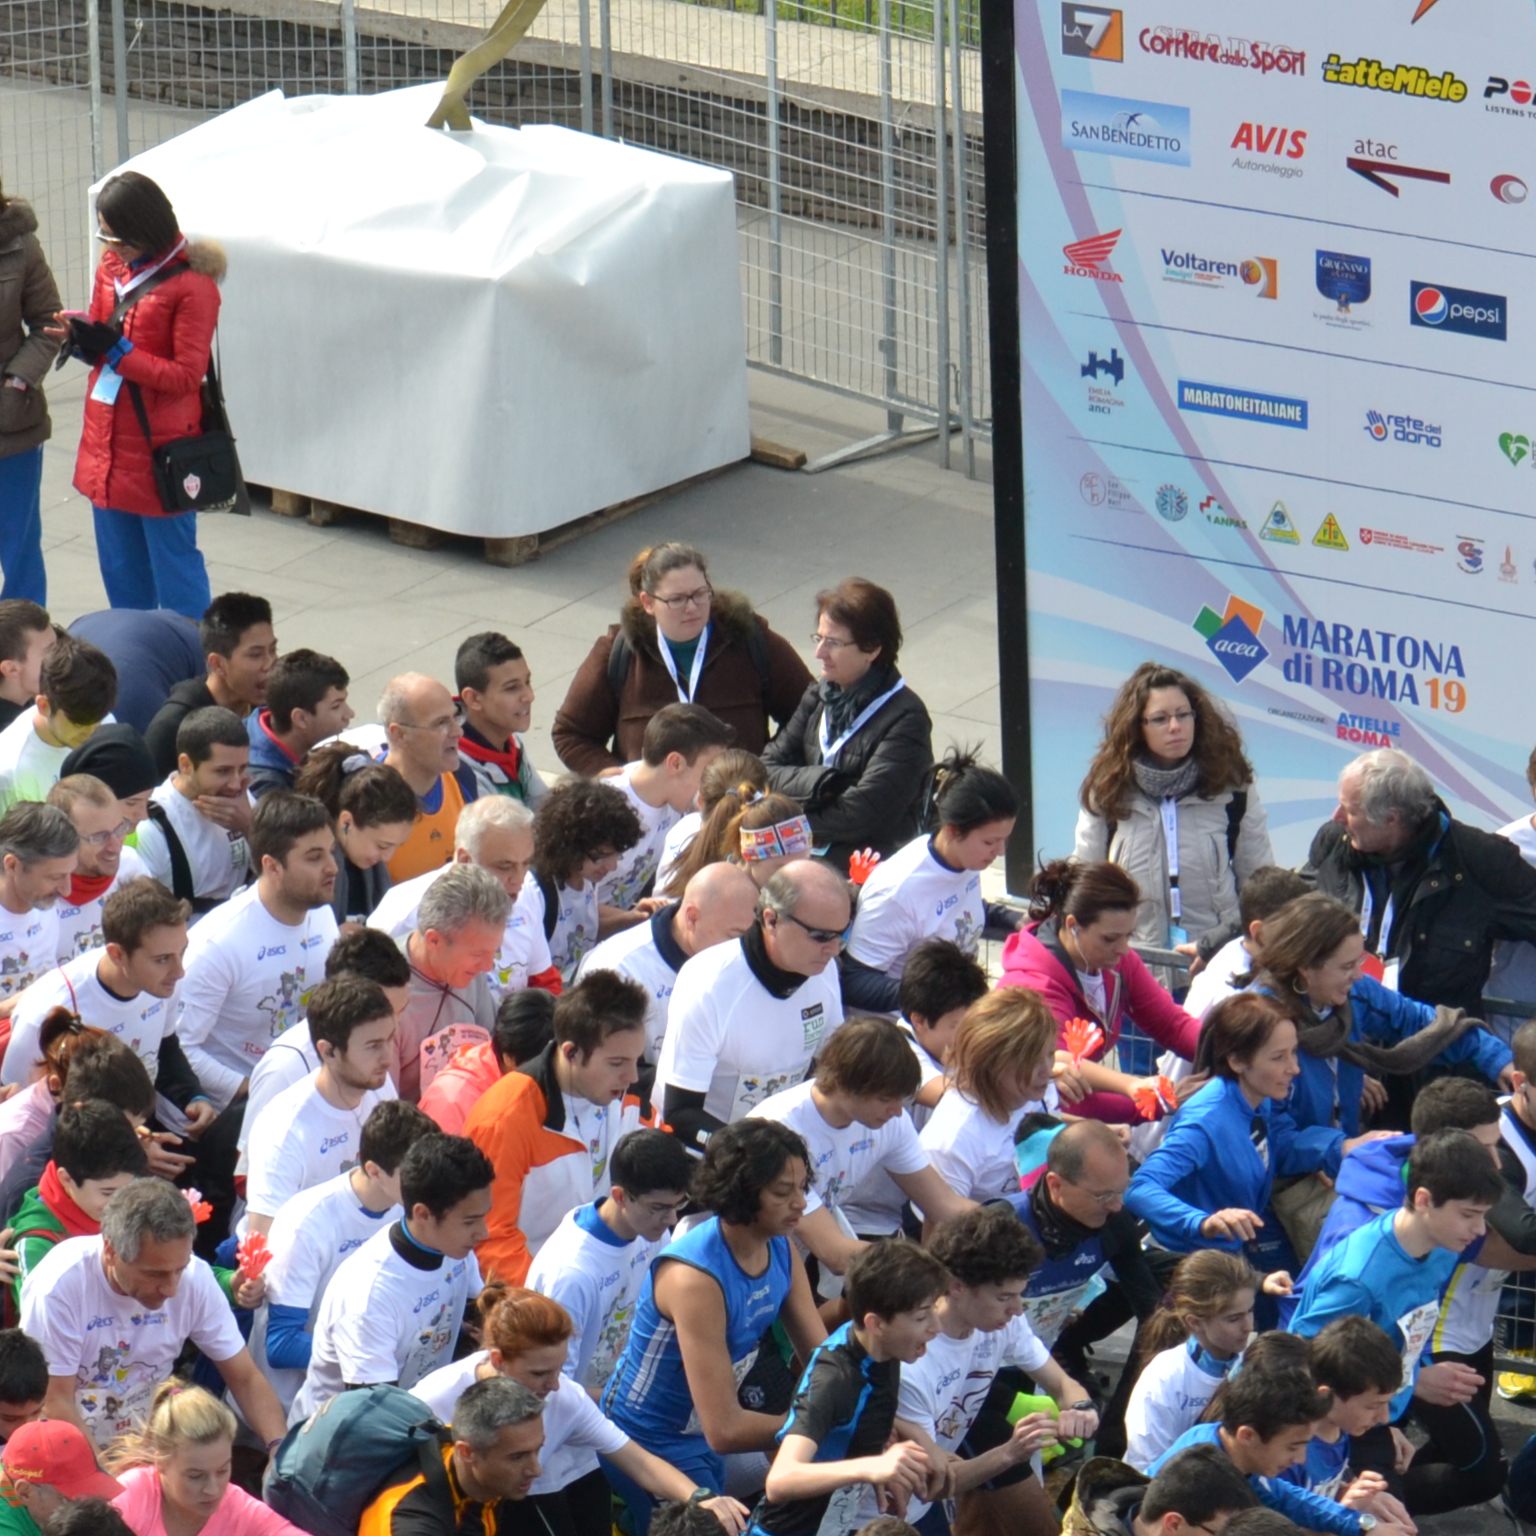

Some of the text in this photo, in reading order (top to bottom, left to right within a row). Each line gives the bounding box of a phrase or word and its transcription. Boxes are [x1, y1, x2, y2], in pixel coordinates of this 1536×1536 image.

[1485, 104, 1525, 118] LISTENS
[1230, 122, 1307, 160] AVIS
[1354, 137, 1398, 160] atac
[1232, 157, 1304, 179] Autonoleggio
[1161, 248, 1238, 277] Voltaren
[1063, 265, 1124, 283] HONDA
[1450, 303, 1500, 324] pepsi
[1387, 413, 1442, 435] rete del
[1393, 429, 1442, 448] dono
[1214, 638, 1259, 658] acea
[1282, 613, 1466, 678] MARATONA
[1282, 652, 1468, 713] di ROMA 19
[1336, 712, 1401, 737] ATIELLE
[1336, 725, 1392, 749] ROMA
